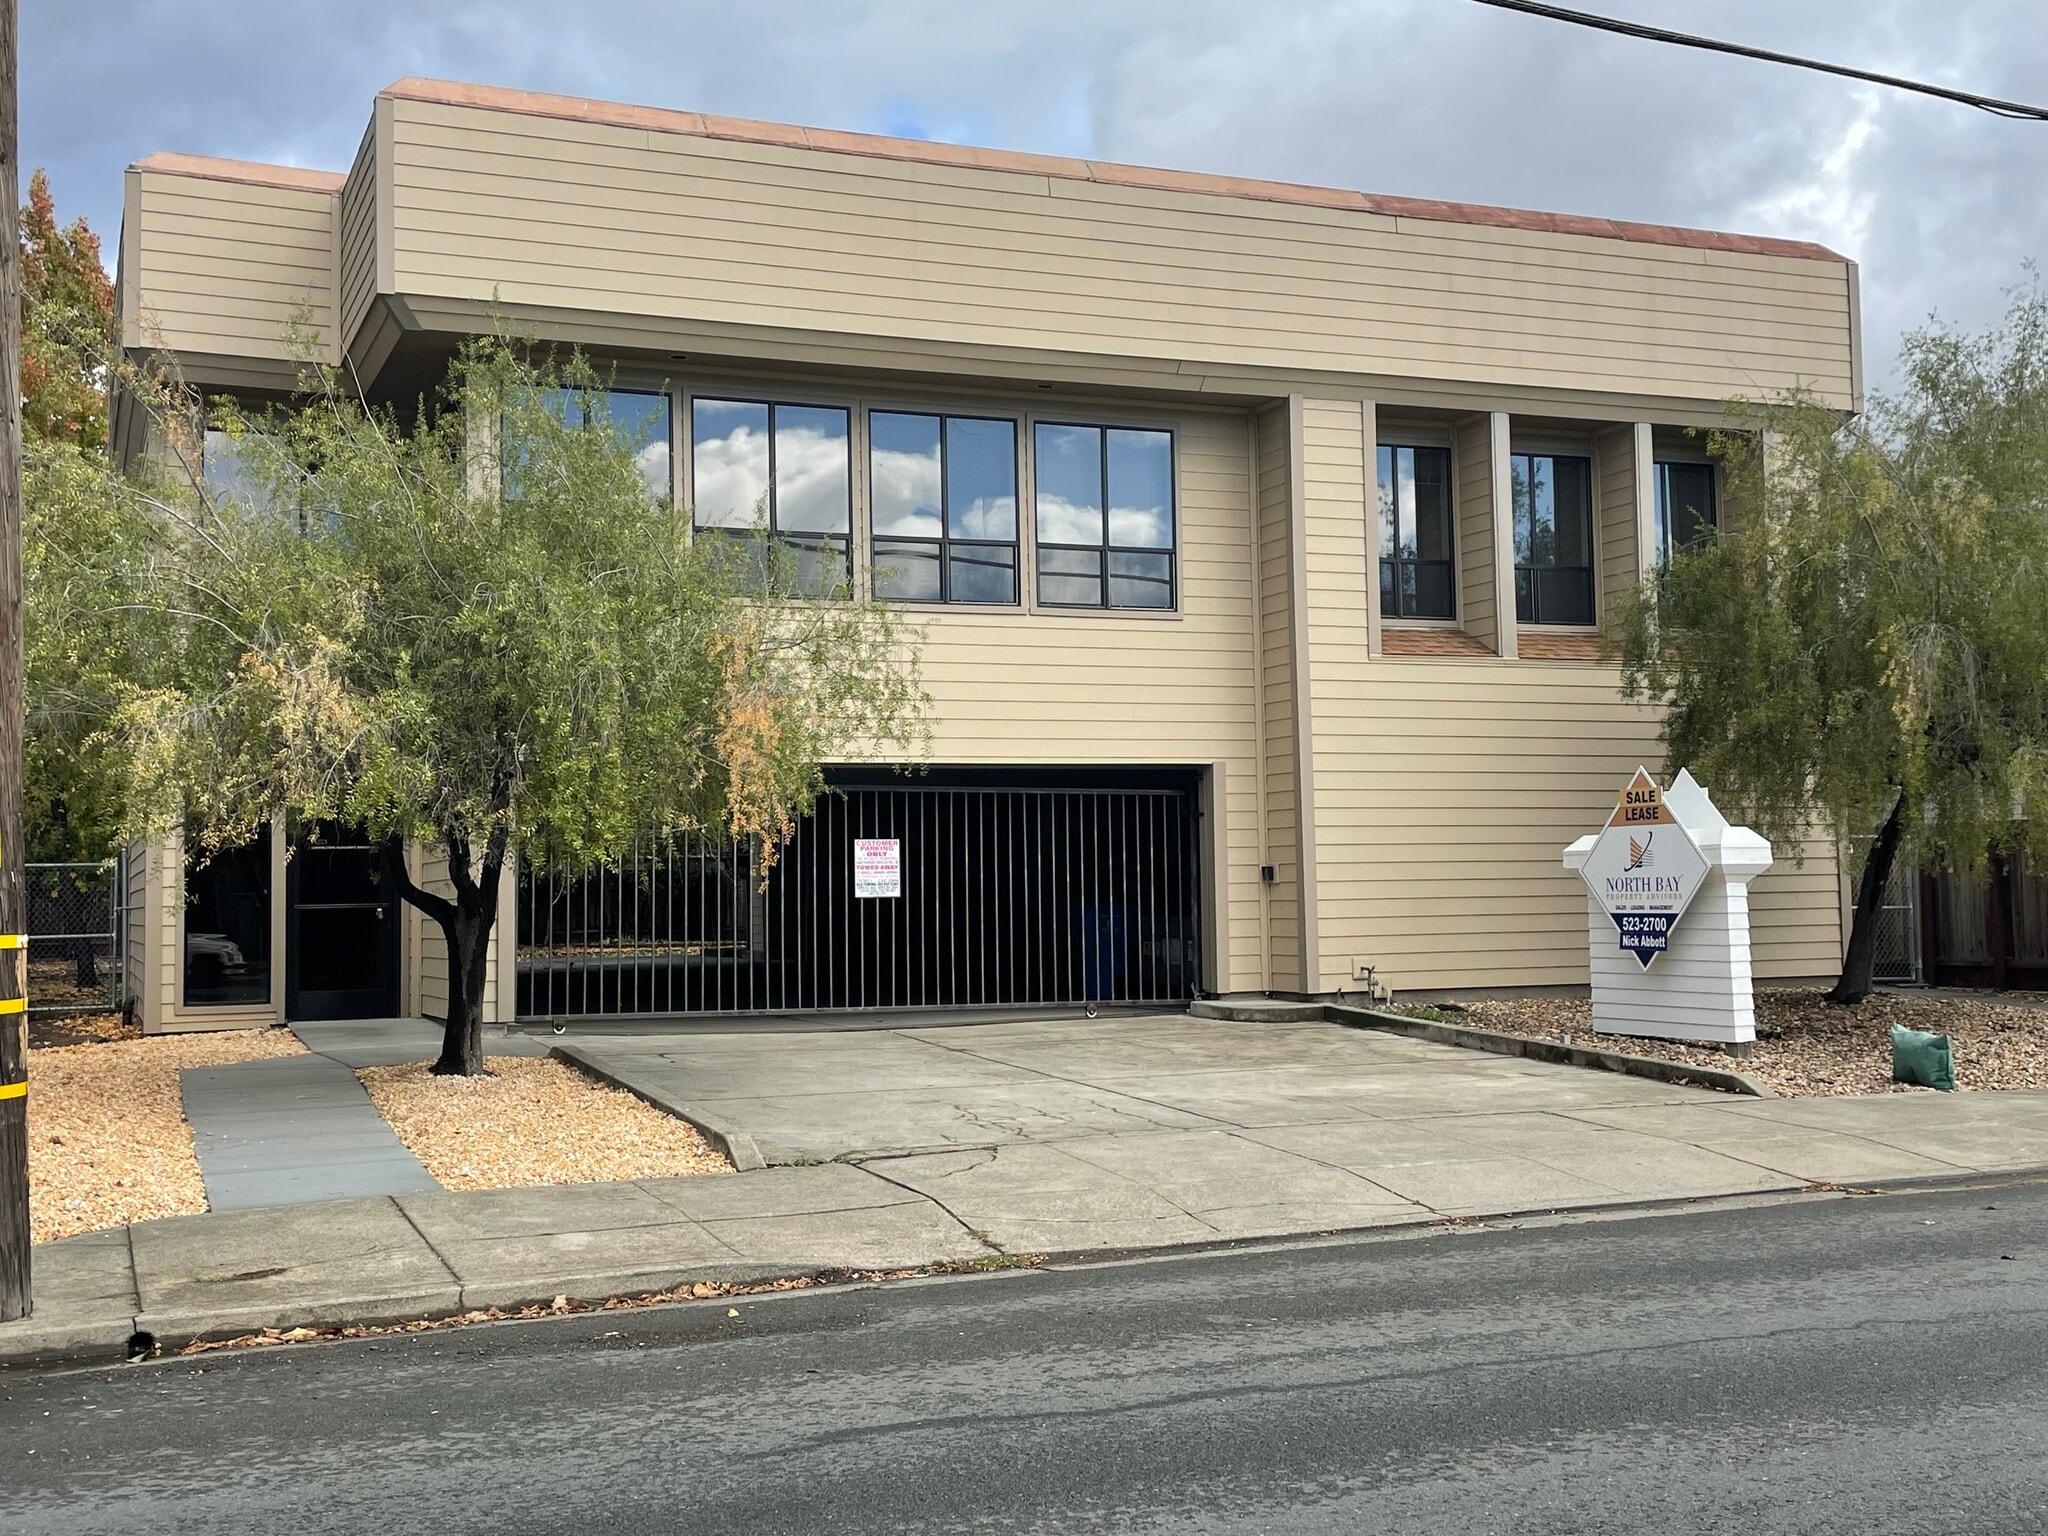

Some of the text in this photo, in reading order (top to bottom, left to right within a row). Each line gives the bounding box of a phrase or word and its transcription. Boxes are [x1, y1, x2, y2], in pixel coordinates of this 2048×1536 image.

[1626, 790, 1656, 804] SALE
[1625, 807, 1659, 821] LEASE
[1606, 876, 1681, 892] NORTH BAY
[1622, 917, 1667, 931] 523-2700
[1622, 934, 1665, 948] Nick Abbott
